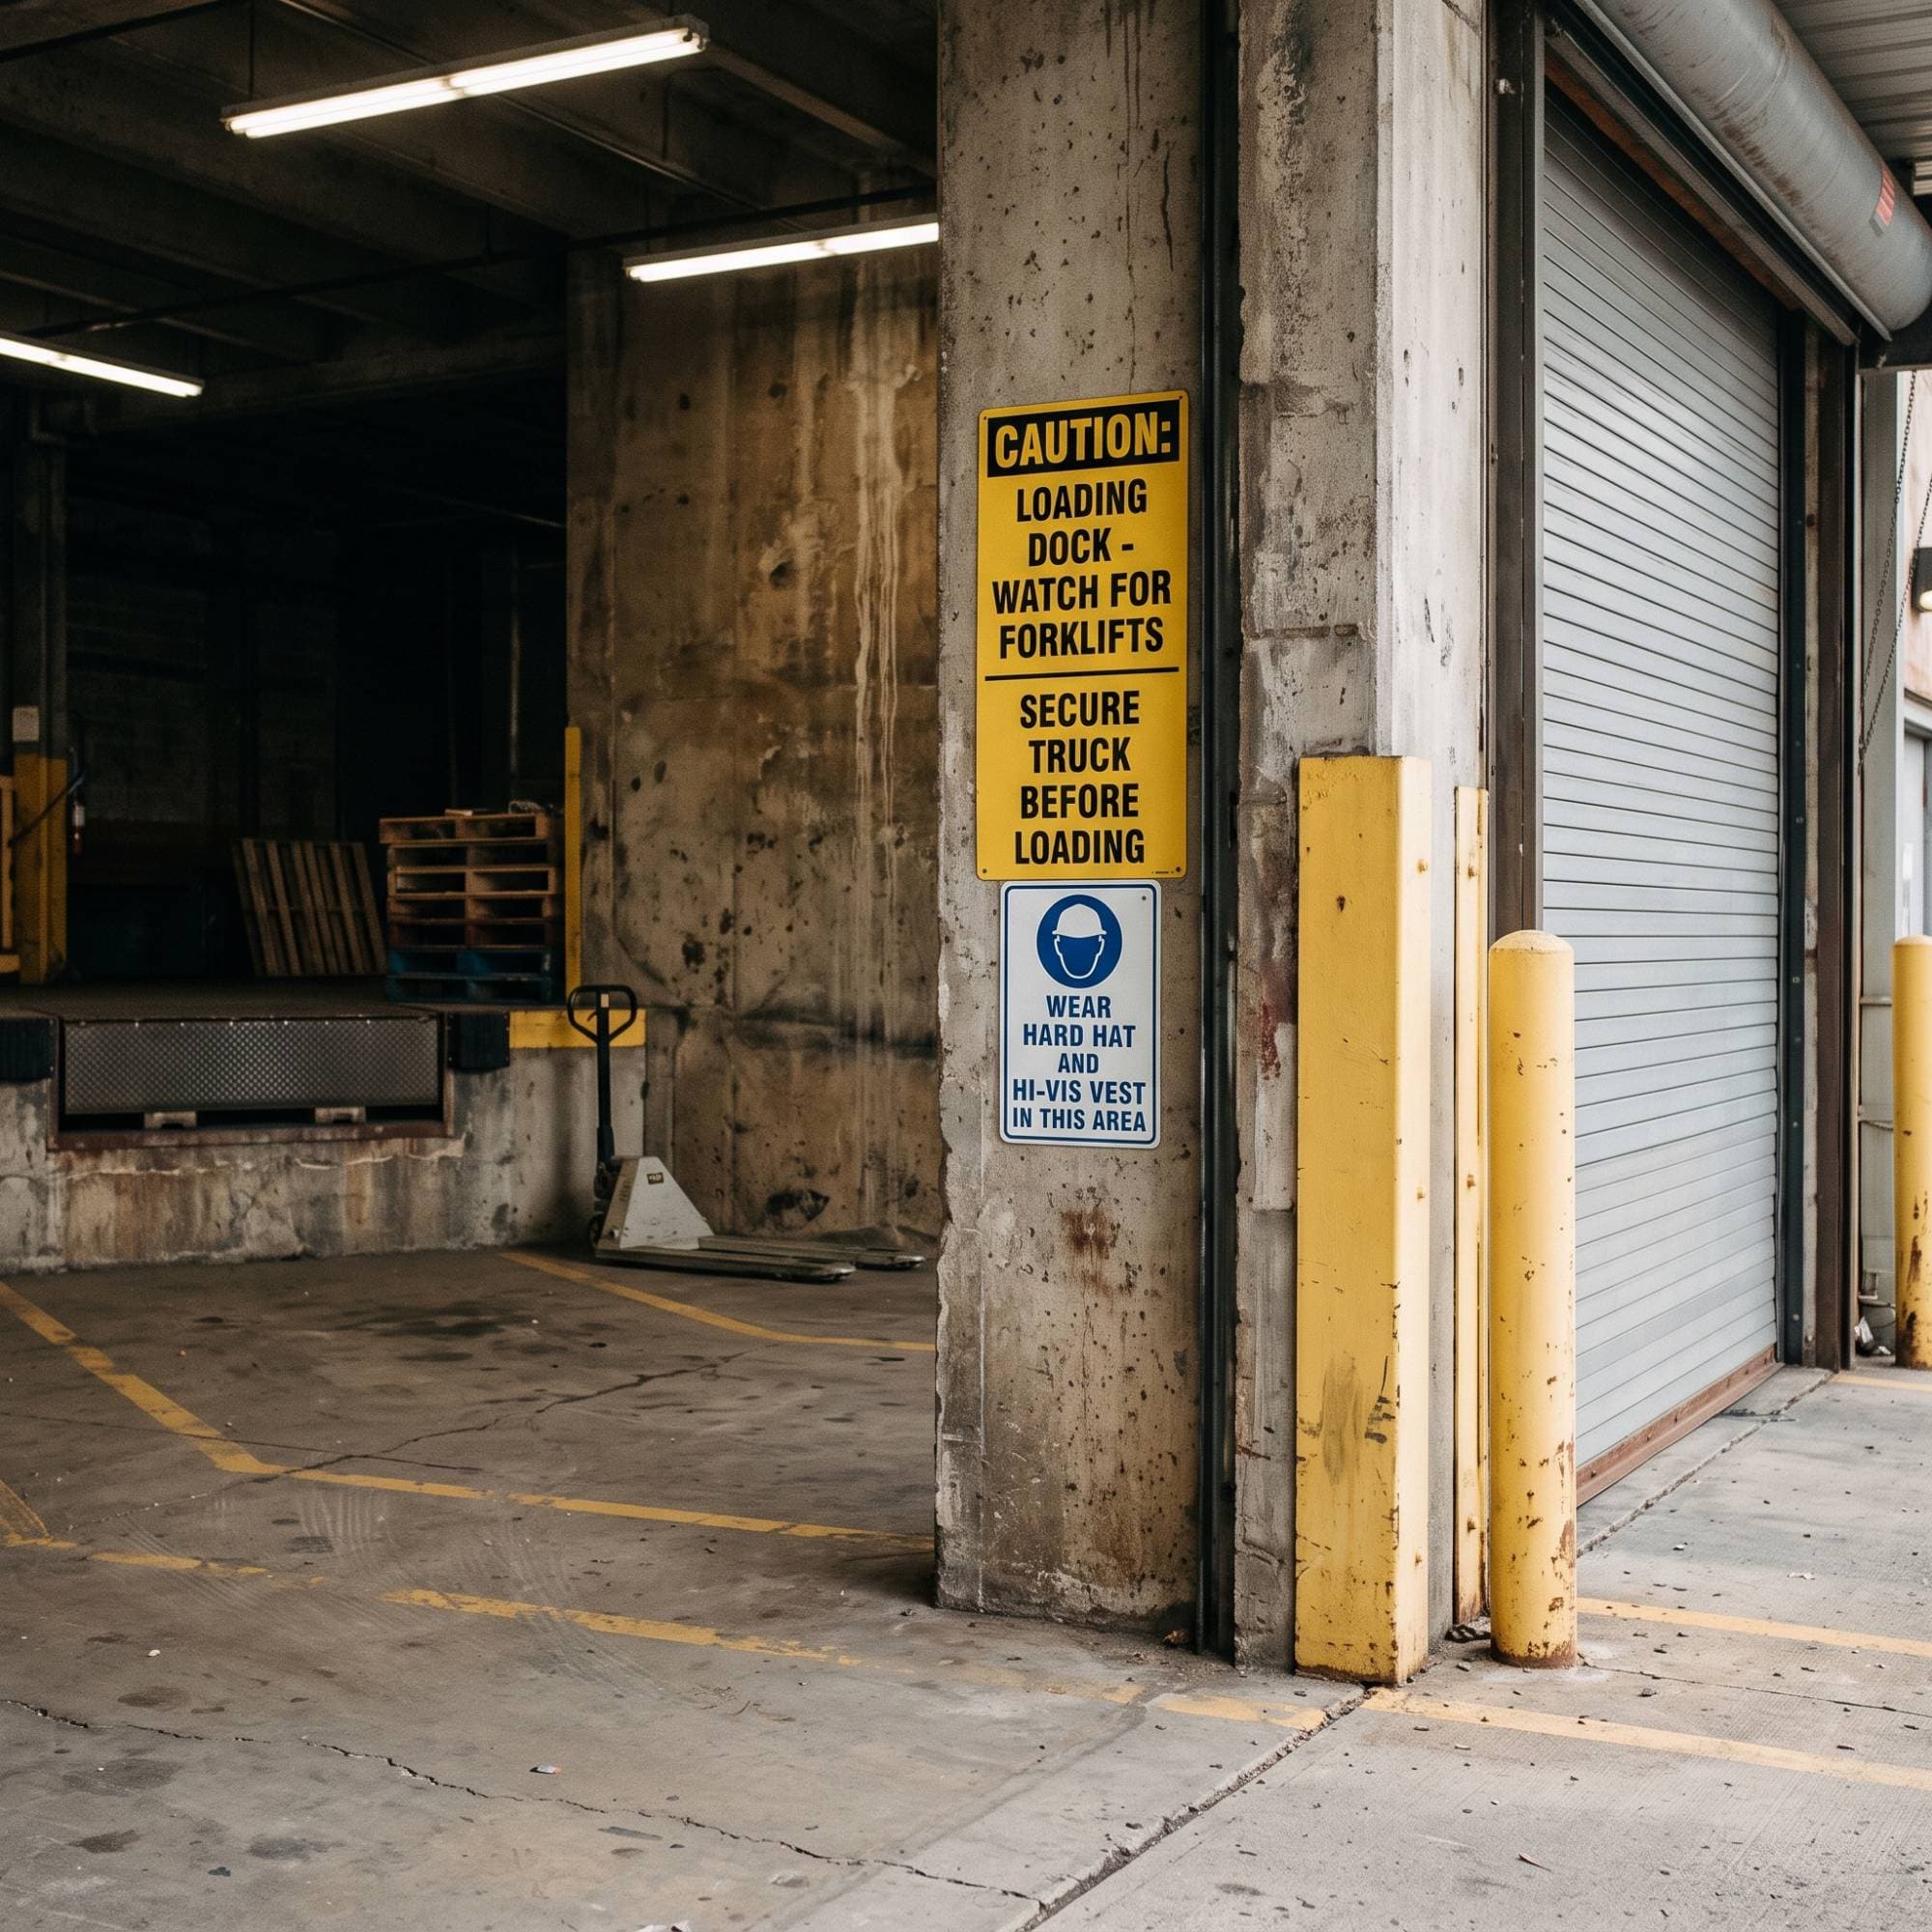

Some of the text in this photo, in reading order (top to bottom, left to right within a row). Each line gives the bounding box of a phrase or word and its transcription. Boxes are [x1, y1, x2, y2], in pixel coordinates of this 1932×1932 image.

[994, 412, 1172, 469] CAUTION:
[1016, 478, 1148, 523] LOADING
[1028, 527, 1112, 567] DOCK
[992, 570, 1172, 614] WATCH FOR
[1000, 616, 1164, 660] FORKLIFTS
[1020, 690, 1140, 729] SECURE
[1028, 737, 1131, 774] TRUCK
[1020, 782, 1139, 819] BEFORE
[1014, 828, 1145, 866] LOADING
[1046, 995, 1112, 1019] WEAR
[1023, 1023, 1137, 1048] HARD HAT
[1057, 1052, 1099, 1074] AND
[1012, 1078, 1147, 1105] HI-VIS VEST
[1012, 1107, 1147, 1132] IN THIS AREA
